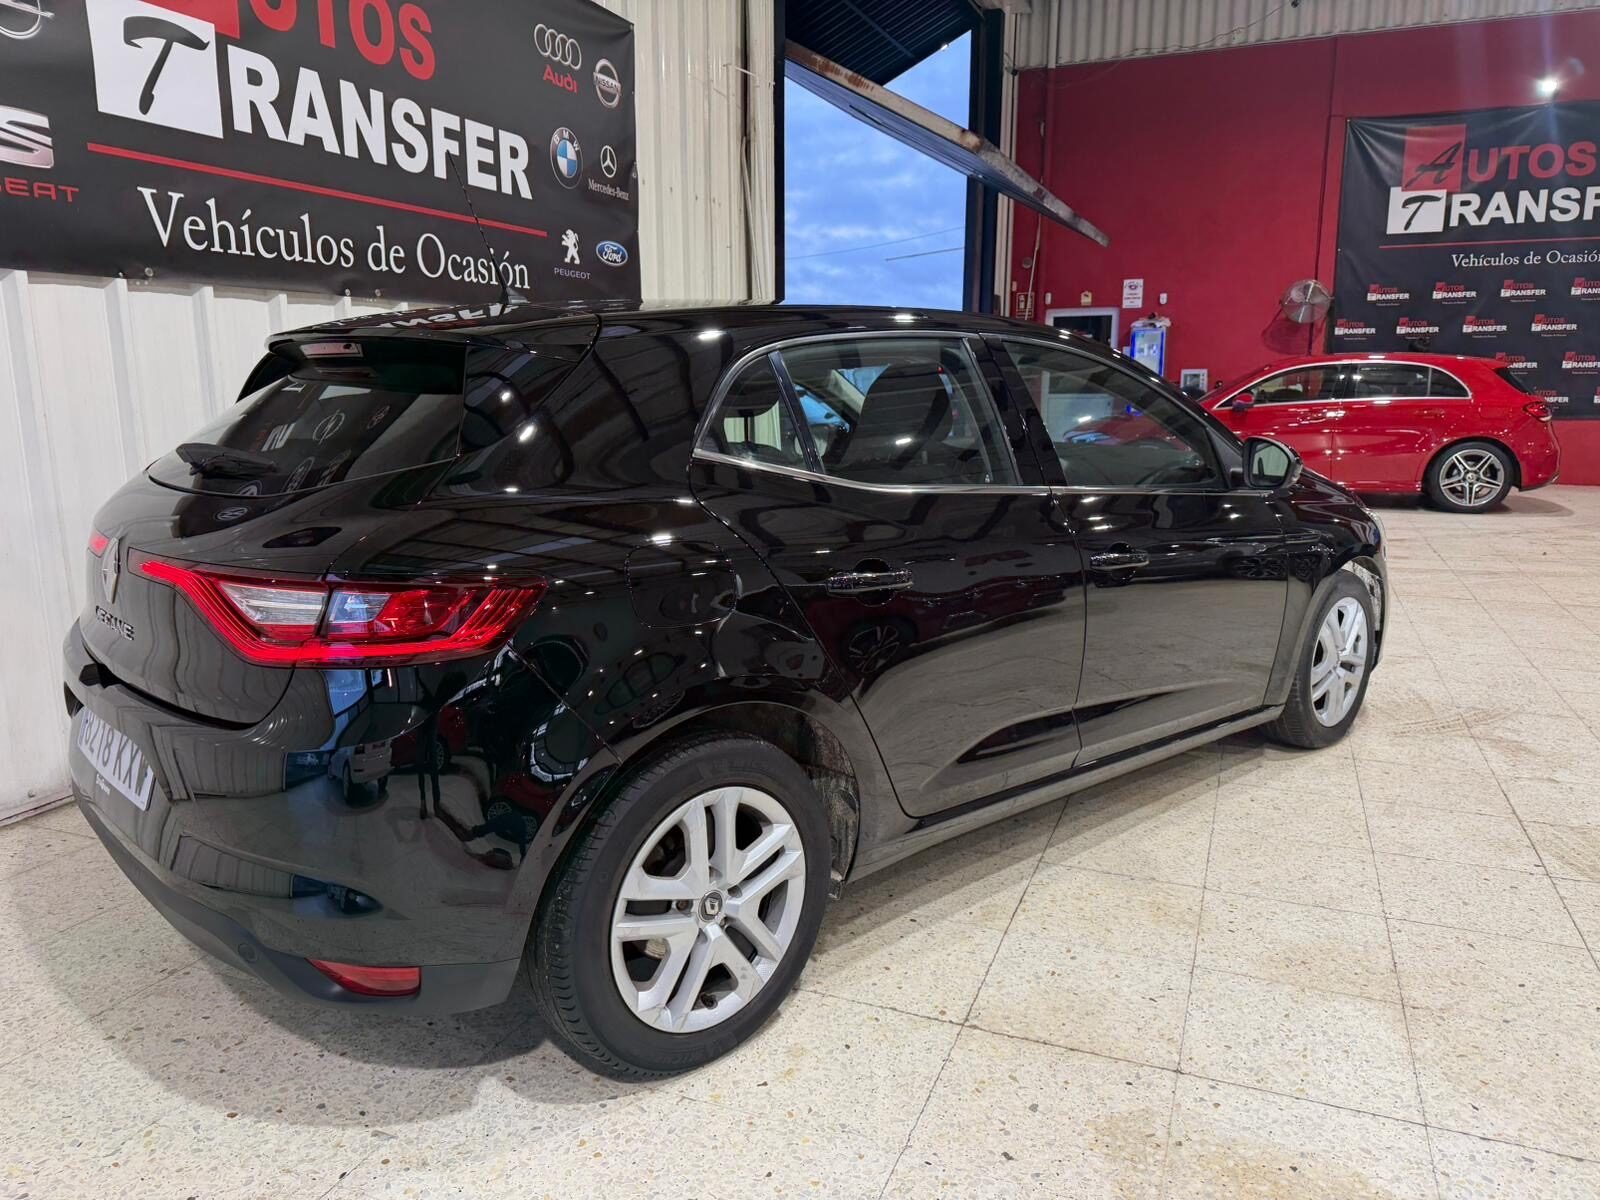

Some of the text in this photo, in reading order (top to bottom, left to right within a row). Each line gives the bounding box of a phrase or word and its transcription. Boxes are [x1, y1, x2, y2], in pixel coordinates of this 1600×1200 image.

[543, 64, 579, 94] Audi
[123, 16, 532, 200] TRANSFER
[553, 129, 580, 151] BMW
[1404, 141, 1597, 190] AUTOS
[0, 177, 80, 202] EAT
[137, 186, 530, 289] Vehículos de Ocasión
[602, 244, 623, 263] Ford
[1451, 249, 1600, 268] Vehículos de Ocasió
[553, 267, 591, 279] PEUGEOT
